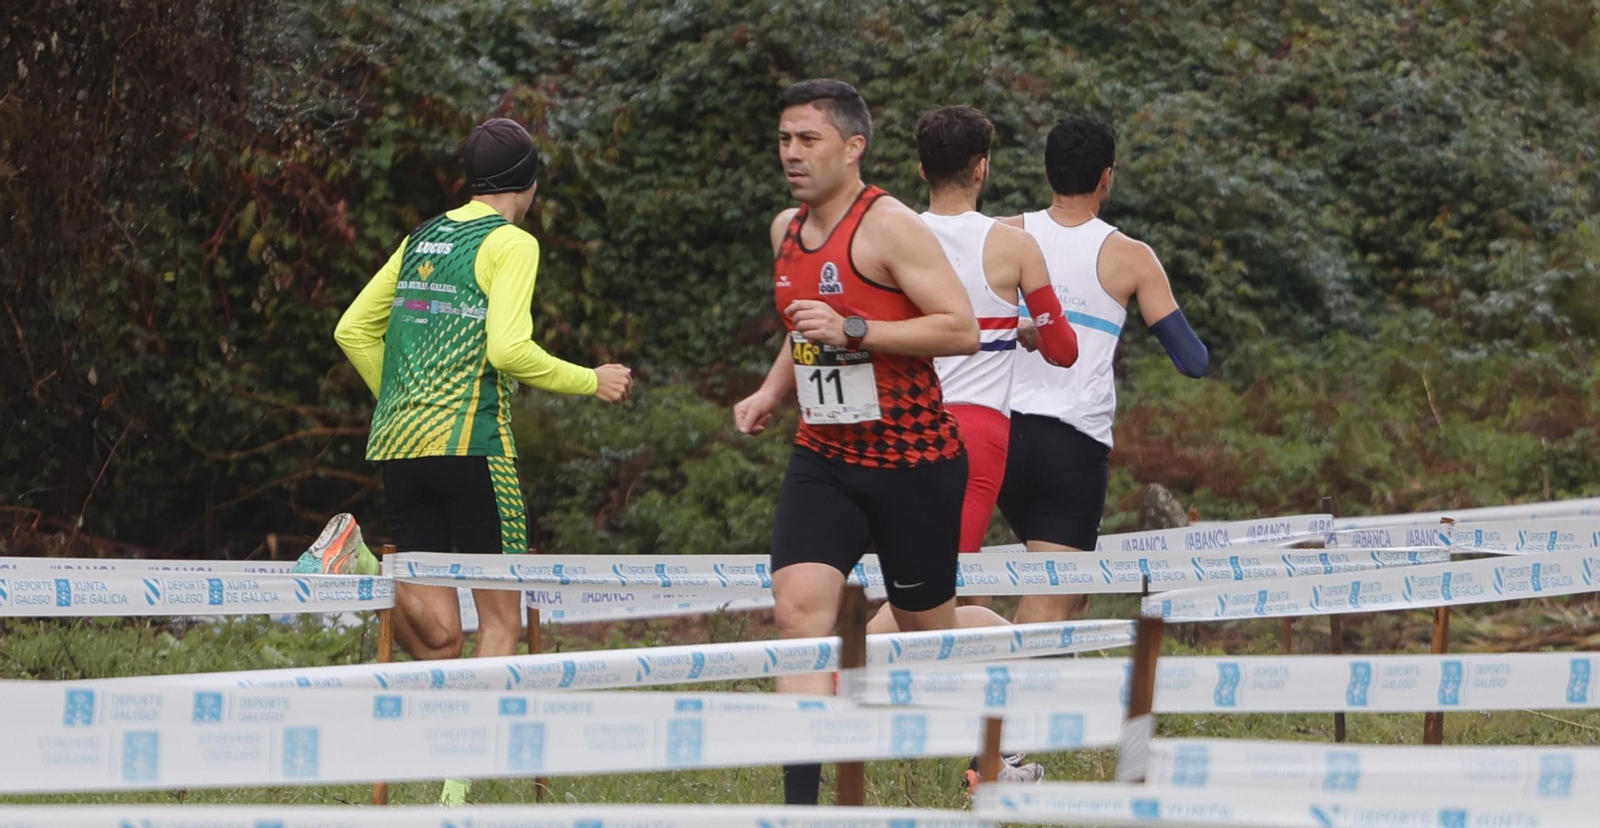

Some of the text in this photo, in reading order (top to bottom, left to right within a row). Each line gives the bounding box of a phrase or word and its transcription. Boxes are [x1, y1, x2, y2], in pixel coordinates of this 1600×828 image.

[415, 241, 453, 254] LUCUS
[430, 282, 457, 293] GALEGA
[835, 352, 869, 360] ALONSO
[809, 369, 844, 405] 11
[1252, 523, 1293, 543] ABANCA
[1126, 536, 1167, 550] ABANCA
[1189, 529, 1231, 549] ABANCA
[1354, 530, 1391, 548] ABANCA
[1295, 555, 1318, 565] DEPORTE
[1331, 553, 1349, 562] XUNTA
[1383, 551, 1408, 560] DEPORTE
[1020, 563, 1045, 572] DEPORTE
[1057, 561, 1077, 571] XUNTA
[1114, 561, 1137, 570] DEPORTE
[1149, 560, 1170, 569] XUNTA
[1205, 558, 1229, 568] DEPORTE
[1240, 557, 1260, 567] XUNTA
[627, 566, 653, 575] DEPORTE
[667, 566, 689, 575] XUNTA
[728, 566, 754, 575] DEPORTE
[962, 563, 983, 573] XUNTA
[1244, 567, 1277, 578] DE GALICIA
[1300, 566, 1320, 575] GALEGO
[1507, 567, 1531, 578] DEPORTE
[1542, 564, 1561, 574] XUNTA
[1024, 574, 1046, 584] GALEGO
[1060, 574, 1093, 584] DE GALICIA
[1117, 573, 1139, 582] GALEGO
[1152, 571, 1186, 581] DE GALICIA
[1209, 569, 1231, 579] GALEGO
[1452, 573, 1473, 583] XUNTA
[167, 580, 206, 590] DEPORTE
[226, 580, 259, 590] XUNTA
[318, 578, 357, 587] DEPORTE
[965, 575, 999, 585] DE GALICIA
[1417, 576, 1441, 587] DEPORTE
[1541, 576, 1574, 588] DE GALICIA
[13, 581, 53, 592] DEPORTE
[73, 581, 107, 592] XUNTA
[1325, 585, 1350, 596] DEPORTE
[1361, 582, 1381, 591] XUNTA
[1453, 585, 1486, 597] DE GALICIA
[1507, 581, 1529, 592] GALEGO
[15, 594, 51, 605] GALEGO
[74, 593, 128, 605] DE GALICIA
[168, 593, 204, 604] GALEGO
[226, 591, 279, 603] DE GALICIA
[318, 591, 353, 600] GALEGO
[1232, 594, 1257, 605] DEPORTE
[1270, 591, 1289, 601] XUNTA
[1359, 593, 1393, 604] DE GALICIA
[1416, 590, 1439, 600] GALEGO
[908, 638, 941, 648] DEPORTE
[955, 634, 983, 644] XUNTA
[1026, 639, 1056, 649] GALEGO
[1073, 633, 1116, 644] DE GALICIA
[784, 645, 817, 657] DEPORTE
[905, 650, 935, 661] GALEGO
[953, 644, 995, 657] DE GALICIA
[656, 655, 690, 667] DEPORTE
[707, 652, 735, 664] XUNTA
[528, 662, 561, 675] DEPORTE
[578, 659, 607, 672] XUNTA
[704, 664, 748, 677] DE GALICIA
[780, 660, 812, 671] GALEGO
[1383, 665, 1421, 676] DEPORTE
[1474, 664, 1511, 675] DEPORTE
[395, 672, 430, 683] DEPORTE
[447, 668, 476, 680] XUNTA
[653, 668, 686, 680] GALEGO
[1250, 666, 1290, 678] DEPORTE
[575, 672, 620, 684] DE GALICIA
[1472, 678, 1507, 688] GALEGO
[1381, 680, 1415, 689] GALEGO
[110, 693, 163, 707] DEPORTE
[238, 697, 291, 709] DEPORTE
[418, 700, 471, 712] DEPORTE
[543, 701, 593, 712] DEPORTE
[110, 710, 157, 721] GALEGO
[237, 711, 285, 722] GALEGO
[1353, 809, 1431, 825] DEPORTE
[1474, 810, 1537, 827] XUNTA
